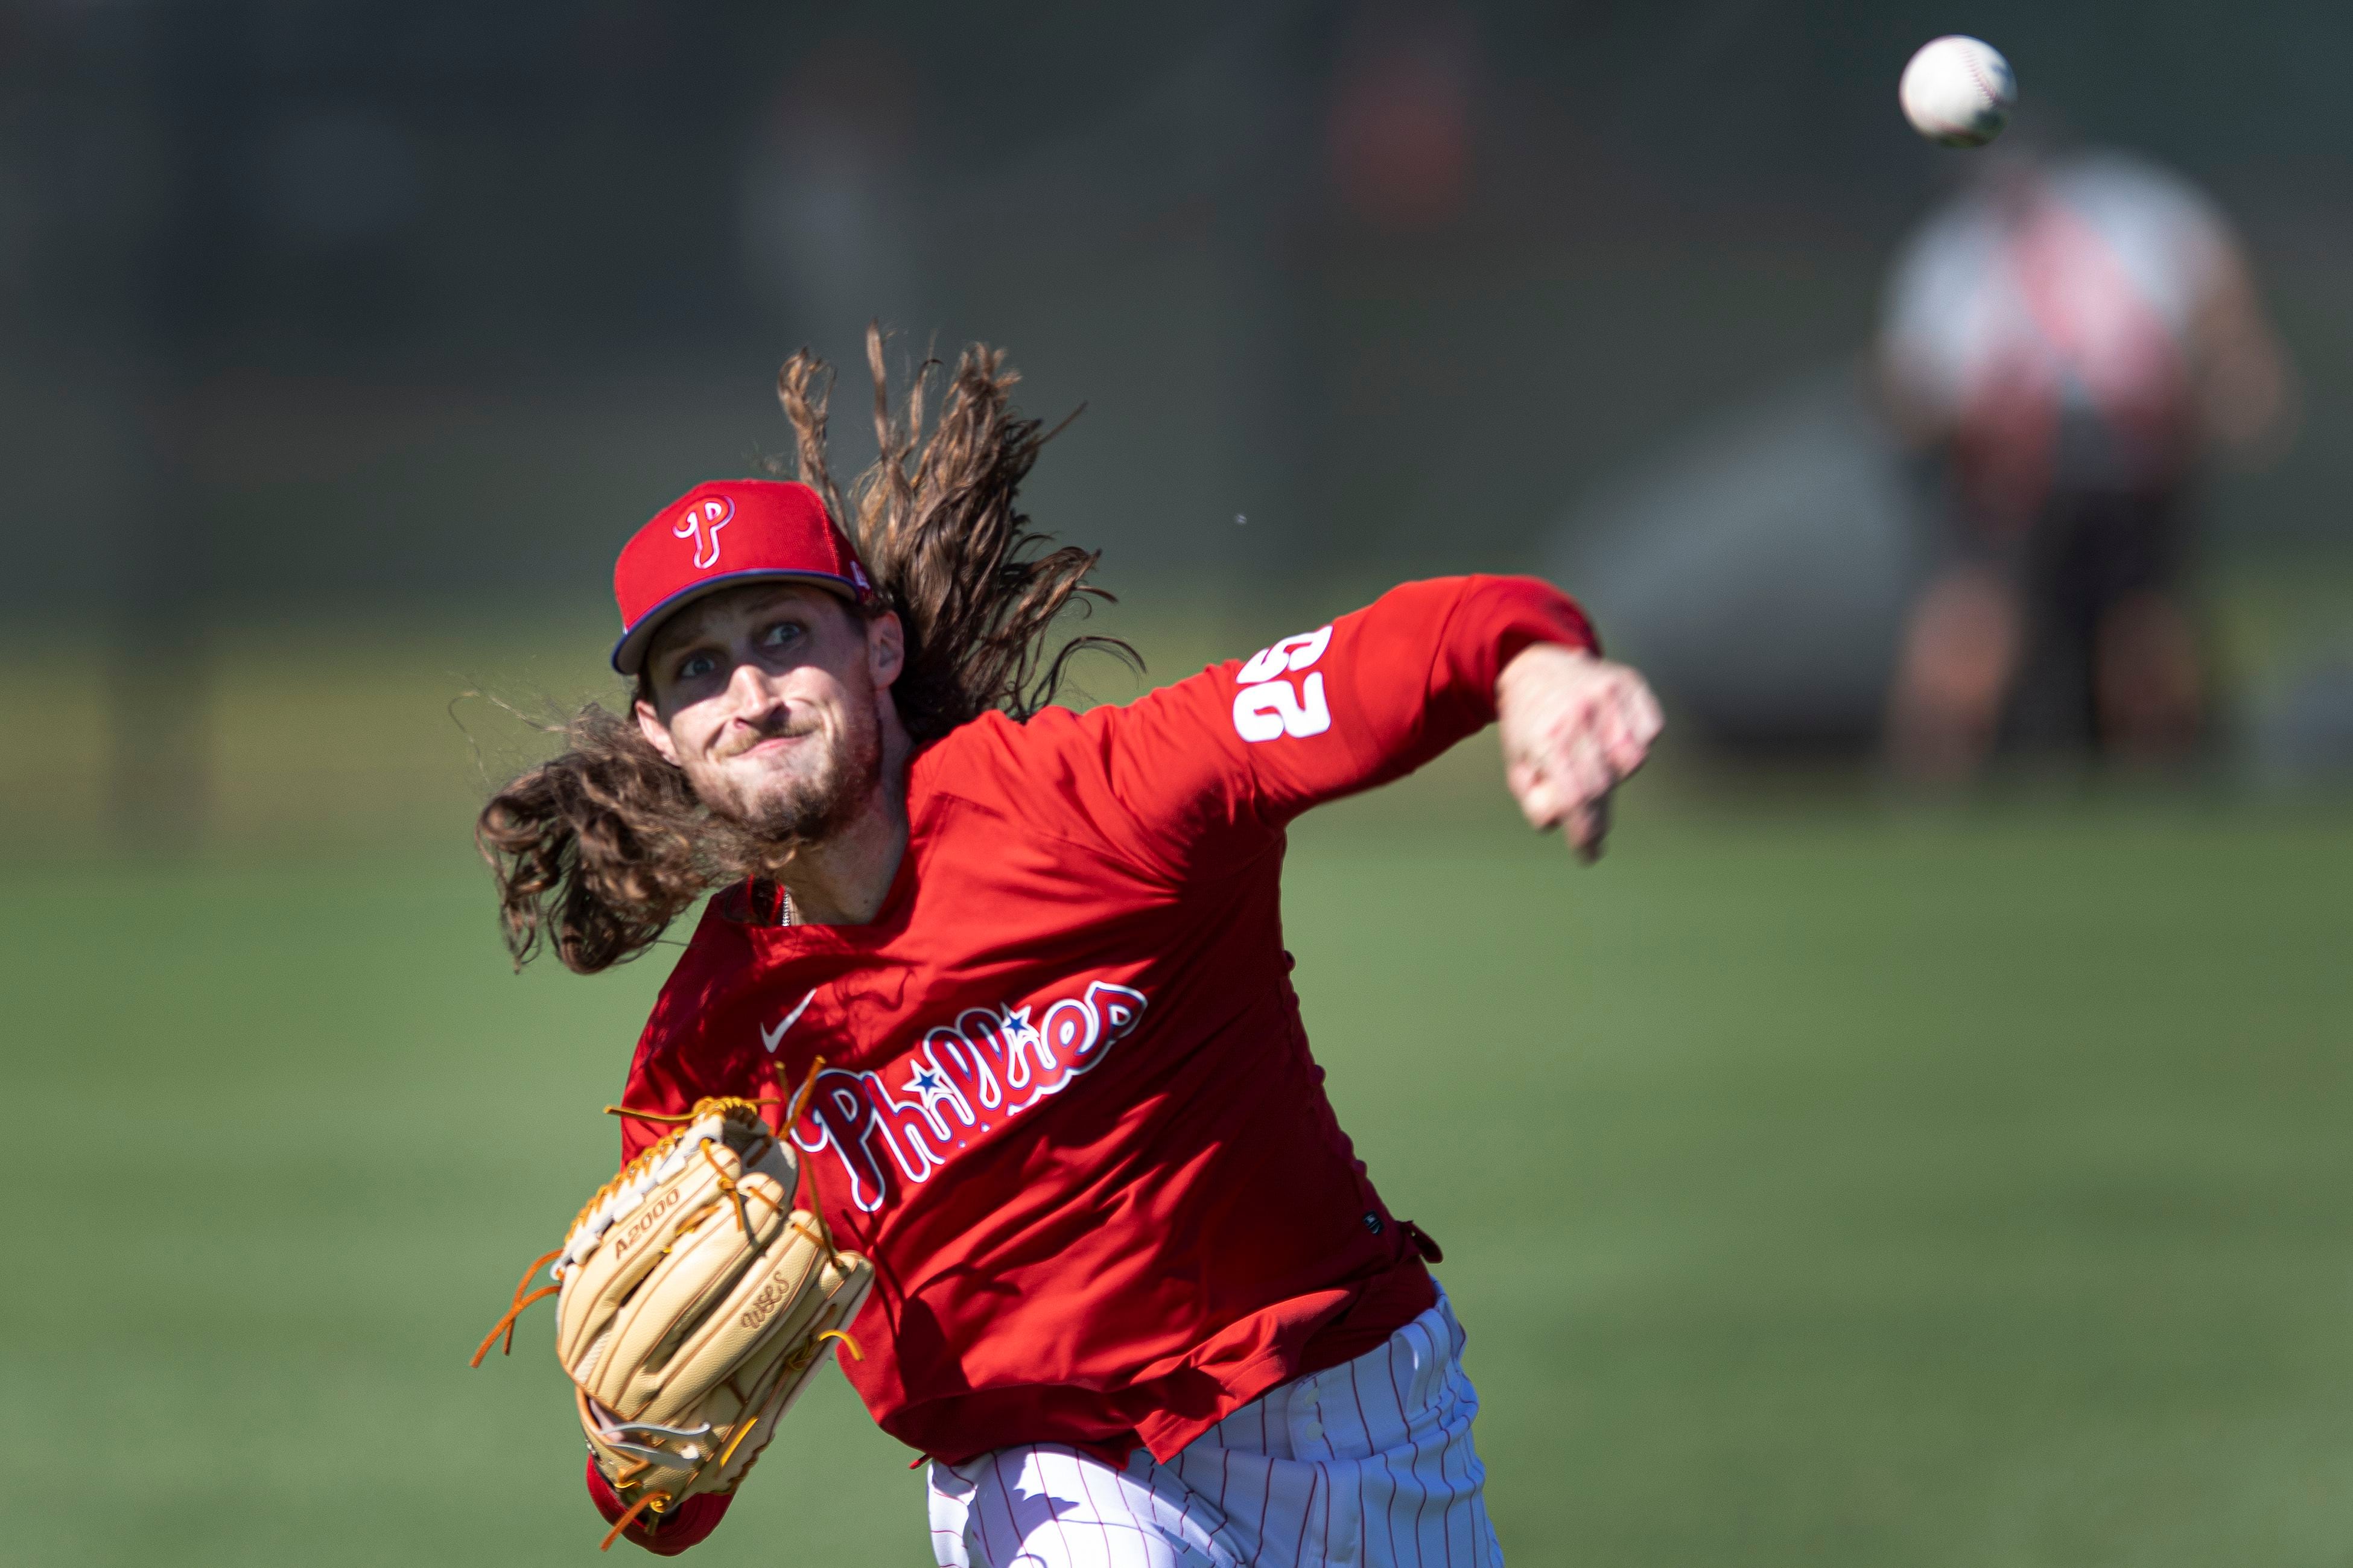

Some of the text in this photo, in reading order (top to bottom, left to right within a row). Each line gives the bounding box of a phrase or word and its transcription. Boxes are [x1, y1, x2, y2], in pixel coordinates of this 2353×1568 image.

[672, 495, 736, 570] P
[1233, 624, 1333, 743] 25
[789, 980, 1147, 1212] Phillies
[615, 1188, 680, 1260] A2000
